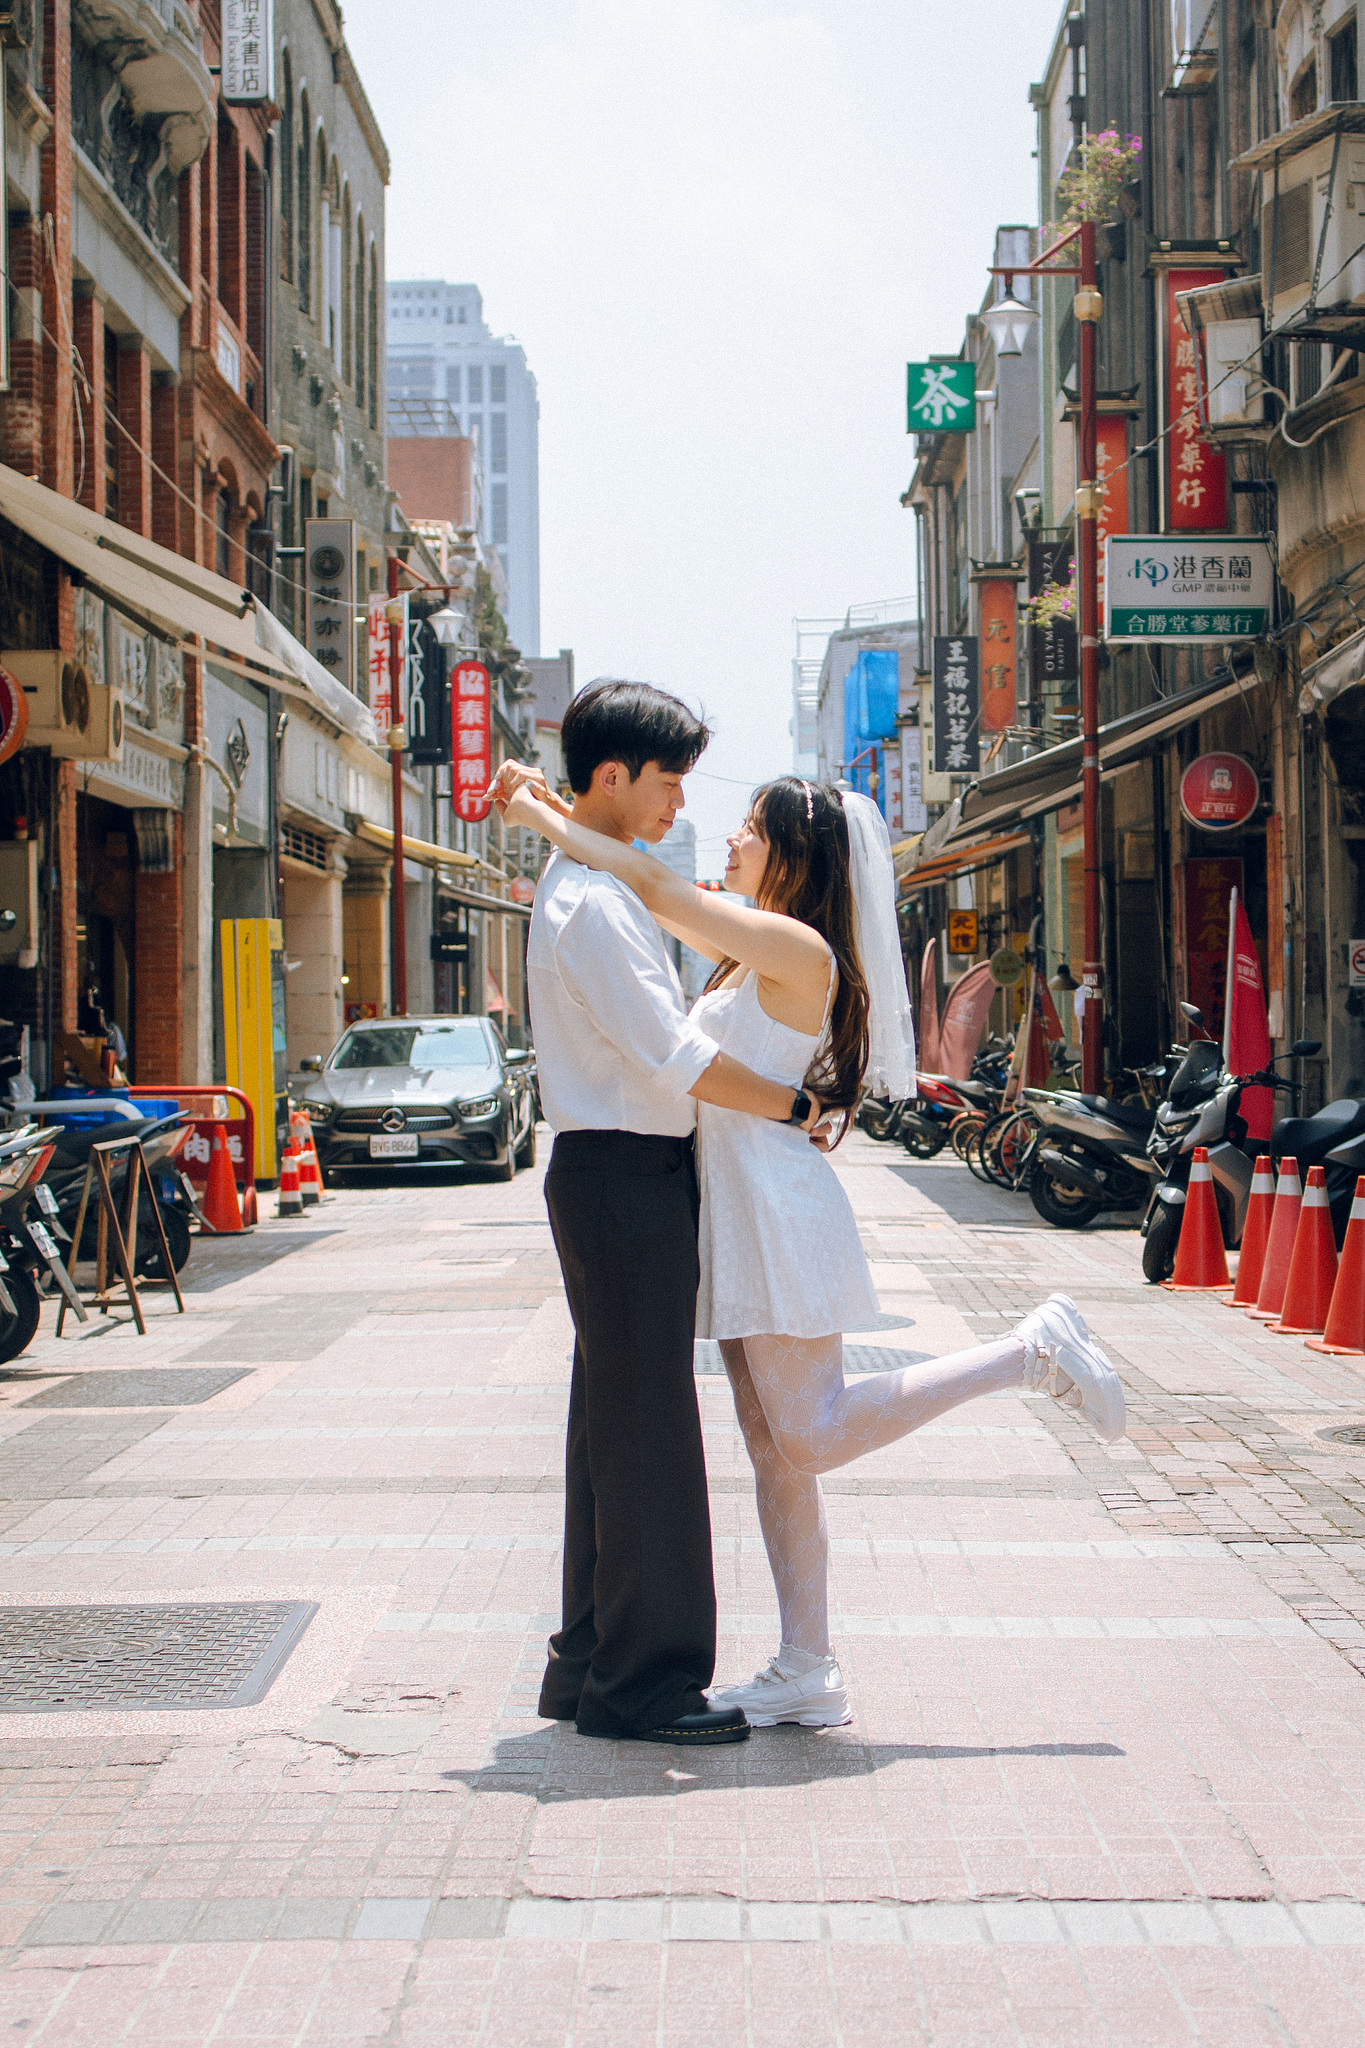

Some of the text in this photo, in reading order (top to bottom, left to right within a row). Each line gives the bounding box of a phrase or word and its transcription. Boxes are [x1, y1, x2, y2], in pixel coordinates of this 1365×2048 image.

[224, 35, 240, 93] Bookshop
[912, 364, 971, 427] 茶
[1172, 555, 1252, 579] 港香蘭
[1172, 583, 1202, 593] GMP
[1127, 613, 1252, 634] 合勝堂蔘藥行
[985, 618, 1011, 690] 元信
[943, 640, 973, 768] 王福記茗茶
[457, 669, 486, 816] 協泰蔘藥行
